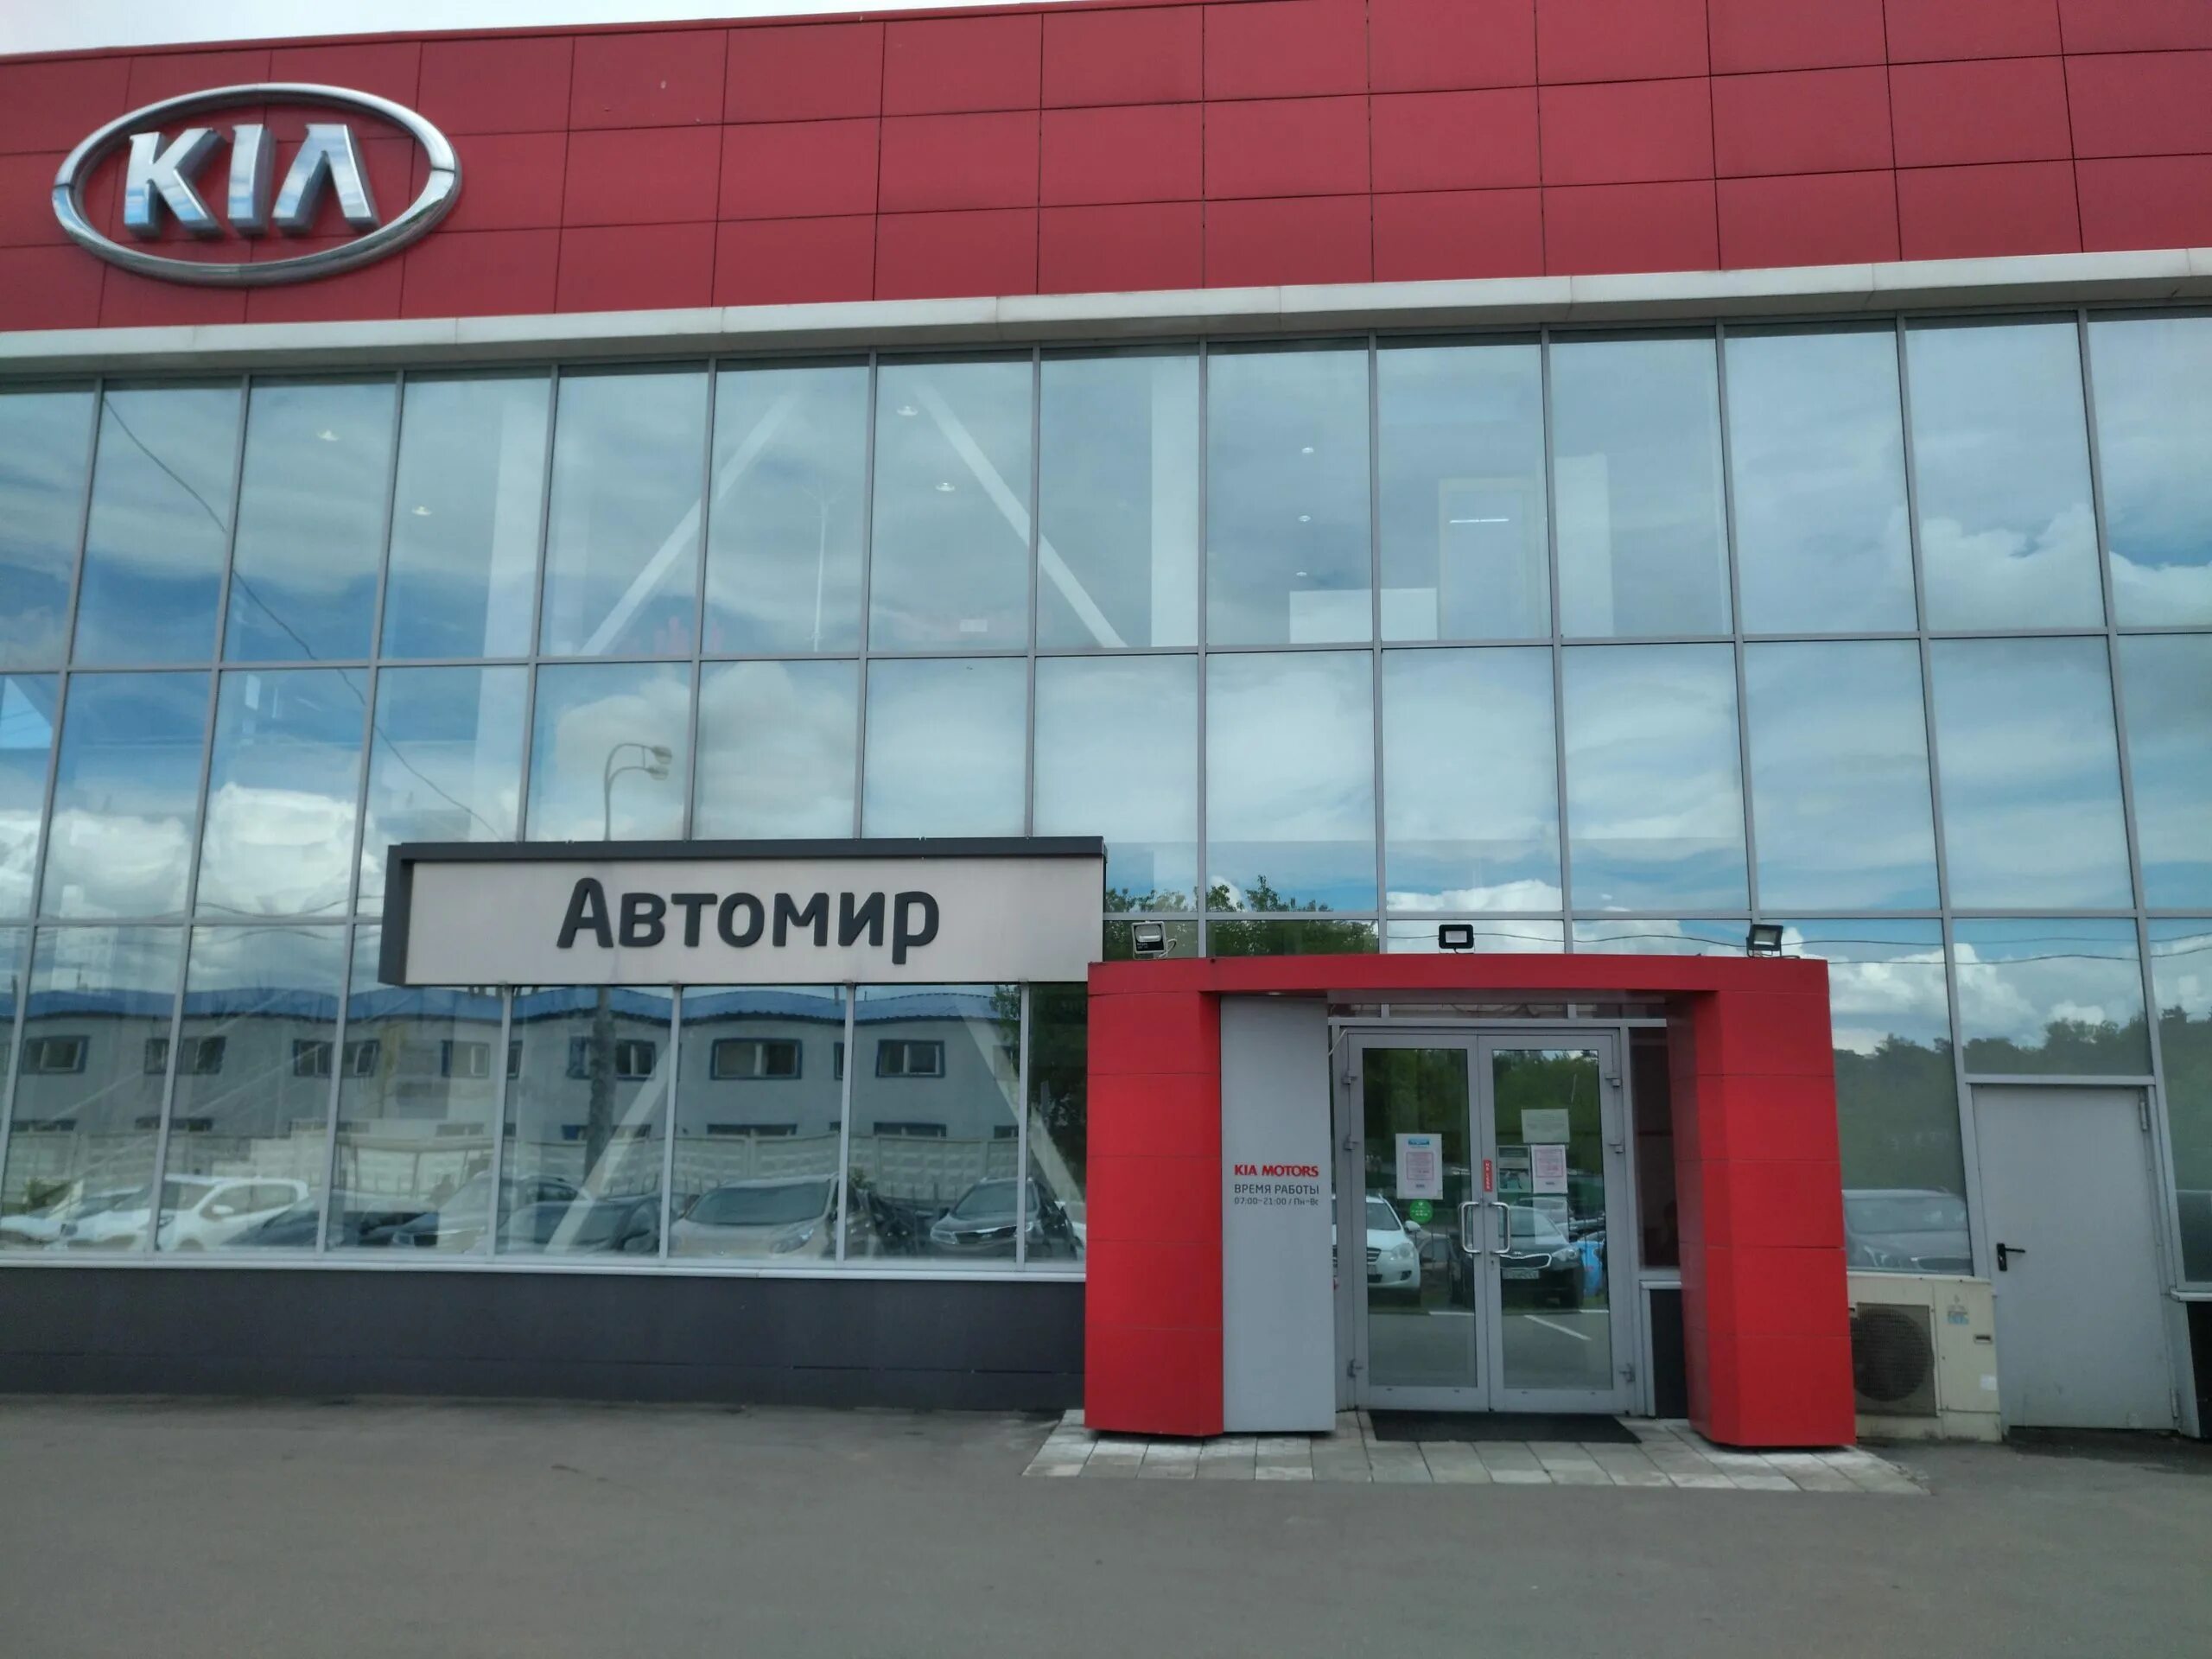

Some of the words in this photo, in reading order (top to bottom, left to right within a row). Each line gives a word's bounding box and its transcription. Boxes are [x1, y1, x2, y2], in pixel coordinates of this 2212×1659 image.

[124, 124, 382, 239] KIA
[556, 877, 940, 965] Автомир
[1234, 1164, 1258, 1176] KIA
[1262, 1164, 1319, 1178] MOTORS
[1234, 1184, 1272, 1194] ВРЕМЯ
[1274, 1185, 1319, 1195] РАБОТЫ
